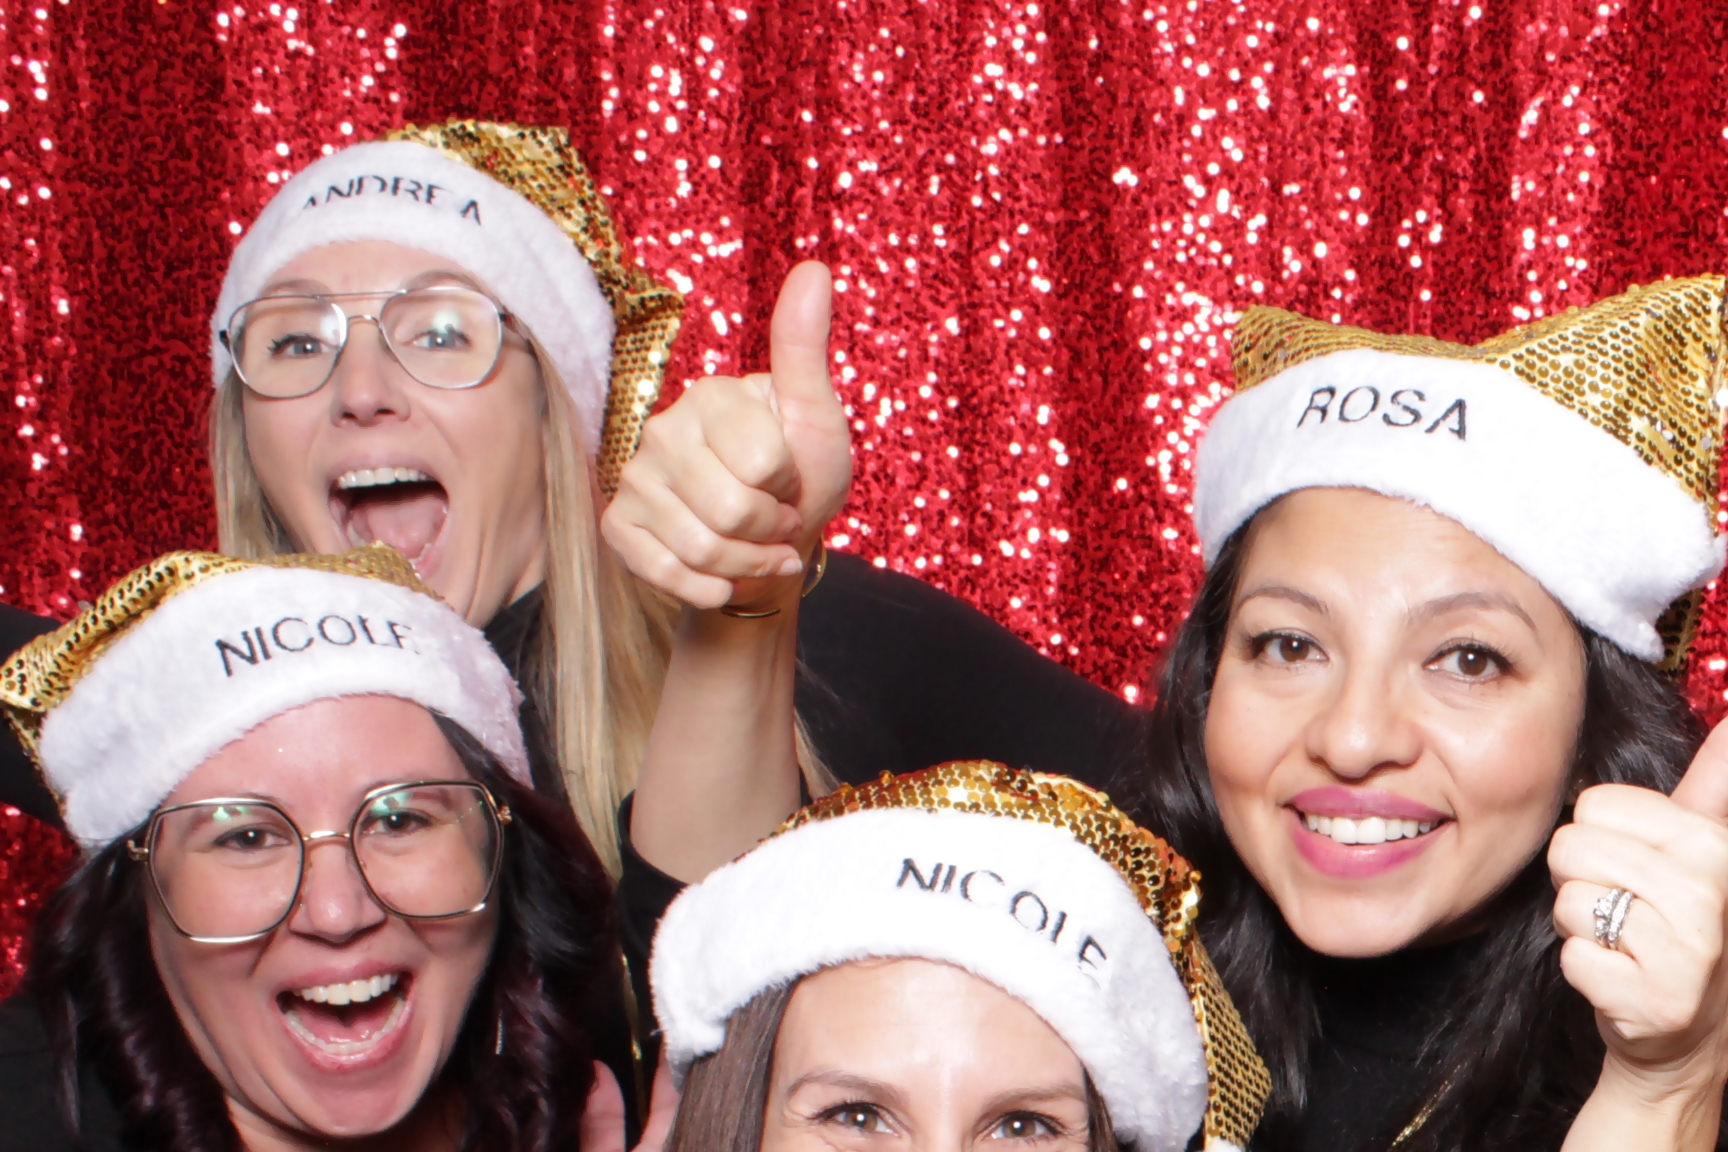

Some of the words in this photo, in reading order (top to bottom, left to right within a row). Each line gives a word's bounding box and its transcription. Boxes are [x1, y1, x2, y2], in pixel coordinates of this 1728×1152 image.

[1297, 385, 1467, 442] ROSA
[215, 614, 421, 677] NICOLE
[896, 857, 1107, 989] NICOLE
